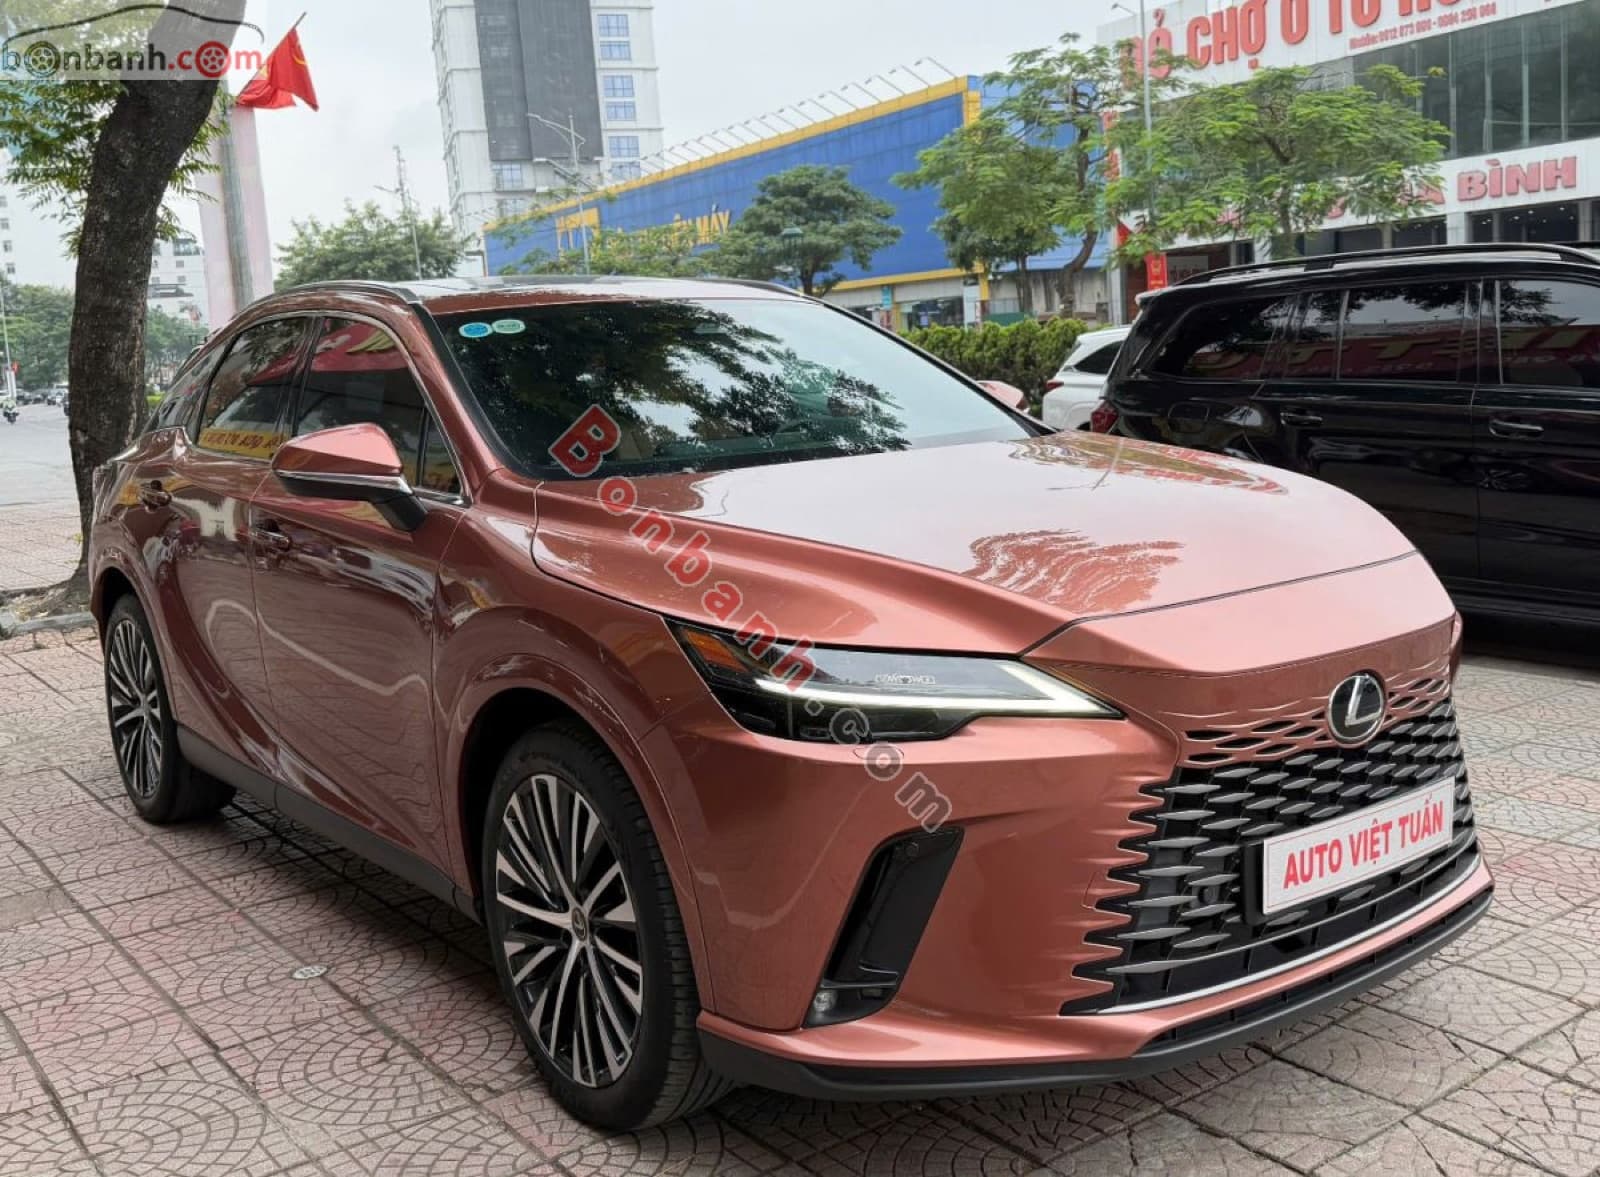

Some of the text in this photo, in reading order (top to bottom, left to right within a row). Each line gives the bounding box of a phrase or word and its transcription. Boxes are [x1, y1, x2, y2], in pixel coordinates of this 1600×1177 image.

[1187, 0, 1266, 69] CHỢ
[1457, 156, 1577, 202] BÌNH
[1283, 793, 1444, 889] AUTO VIỆT TUẤN
